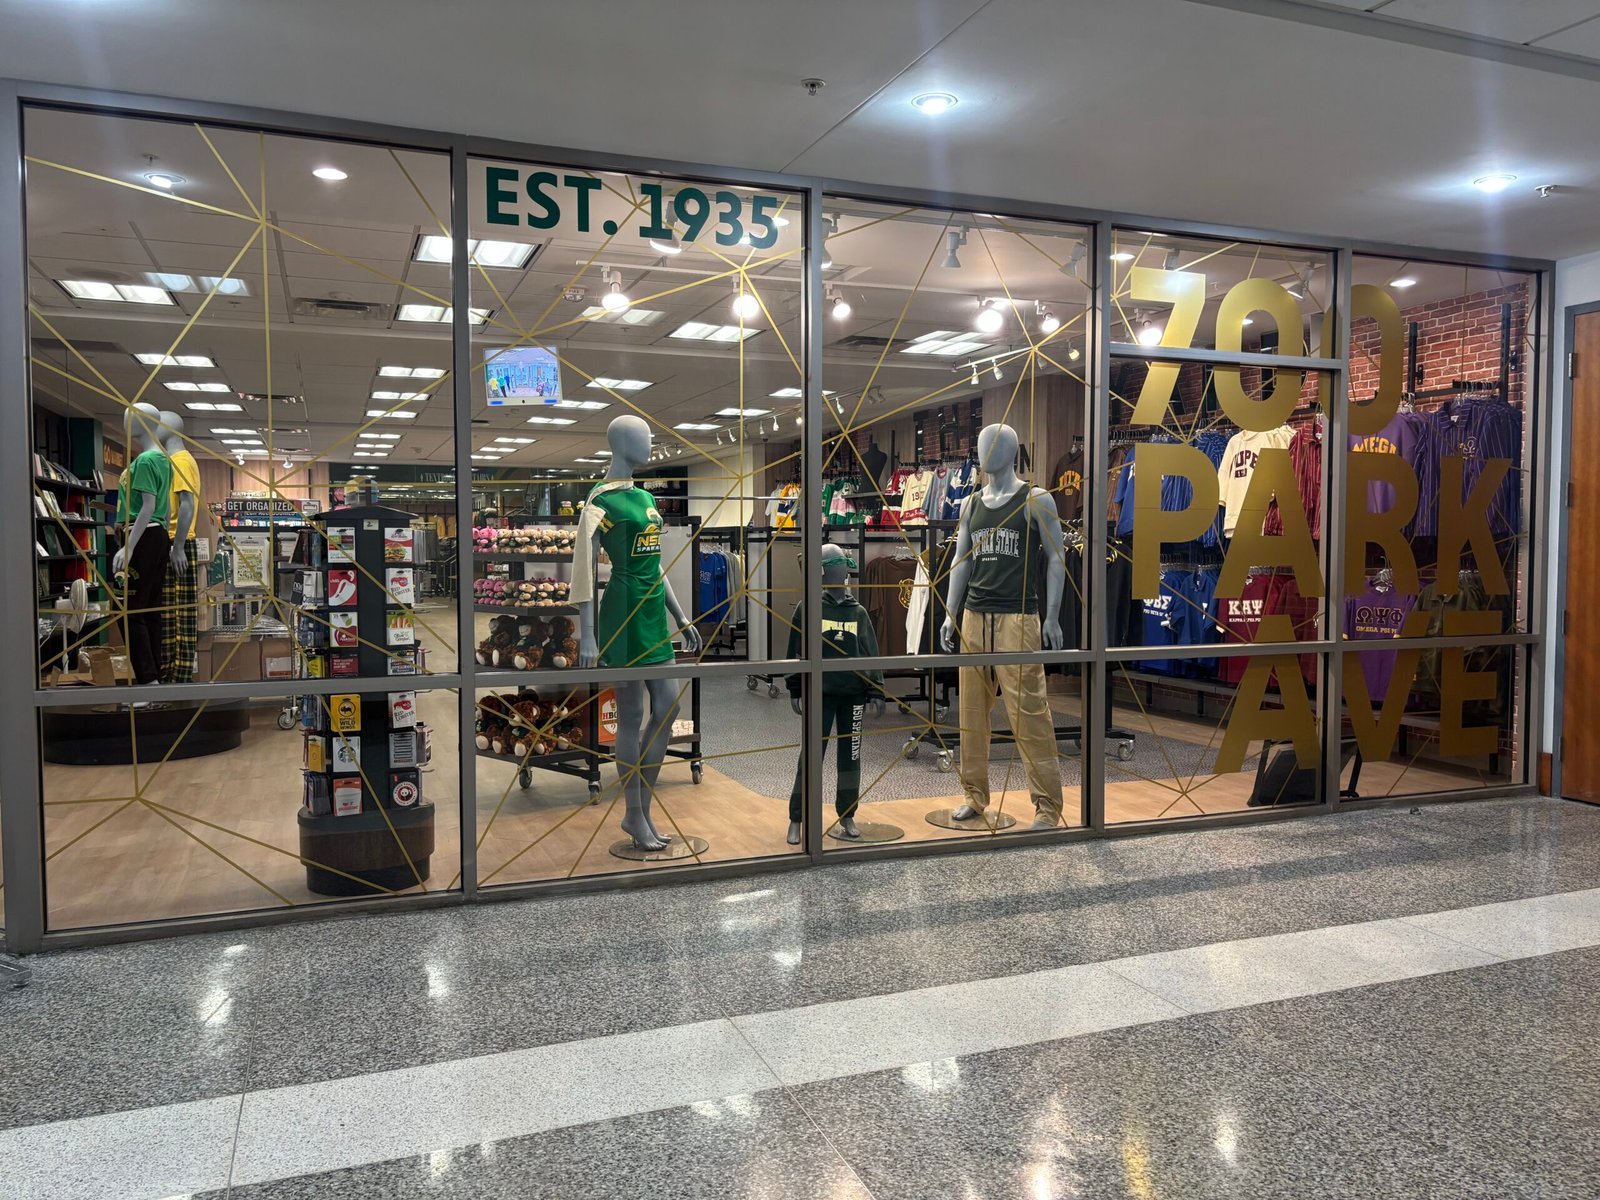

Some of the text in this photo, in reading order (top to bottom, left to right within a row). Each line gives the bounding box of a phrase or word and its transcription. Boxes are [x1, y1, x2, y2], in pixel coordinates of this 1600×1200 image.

[486, 166, 778, 249] EST. 1935
[1130, 266, 1401, 436] 700
[227, 501, 244, 511] GET
[1132, 442, 1510, 600] PARK
[637, 534, 660, 547] NS
[995, 527, 1020, 558] STATE
[1213, 609, 1504, 773] AVE
[602, 711, 617, 720] HBC
[852, 704, 864, 721] NSU
